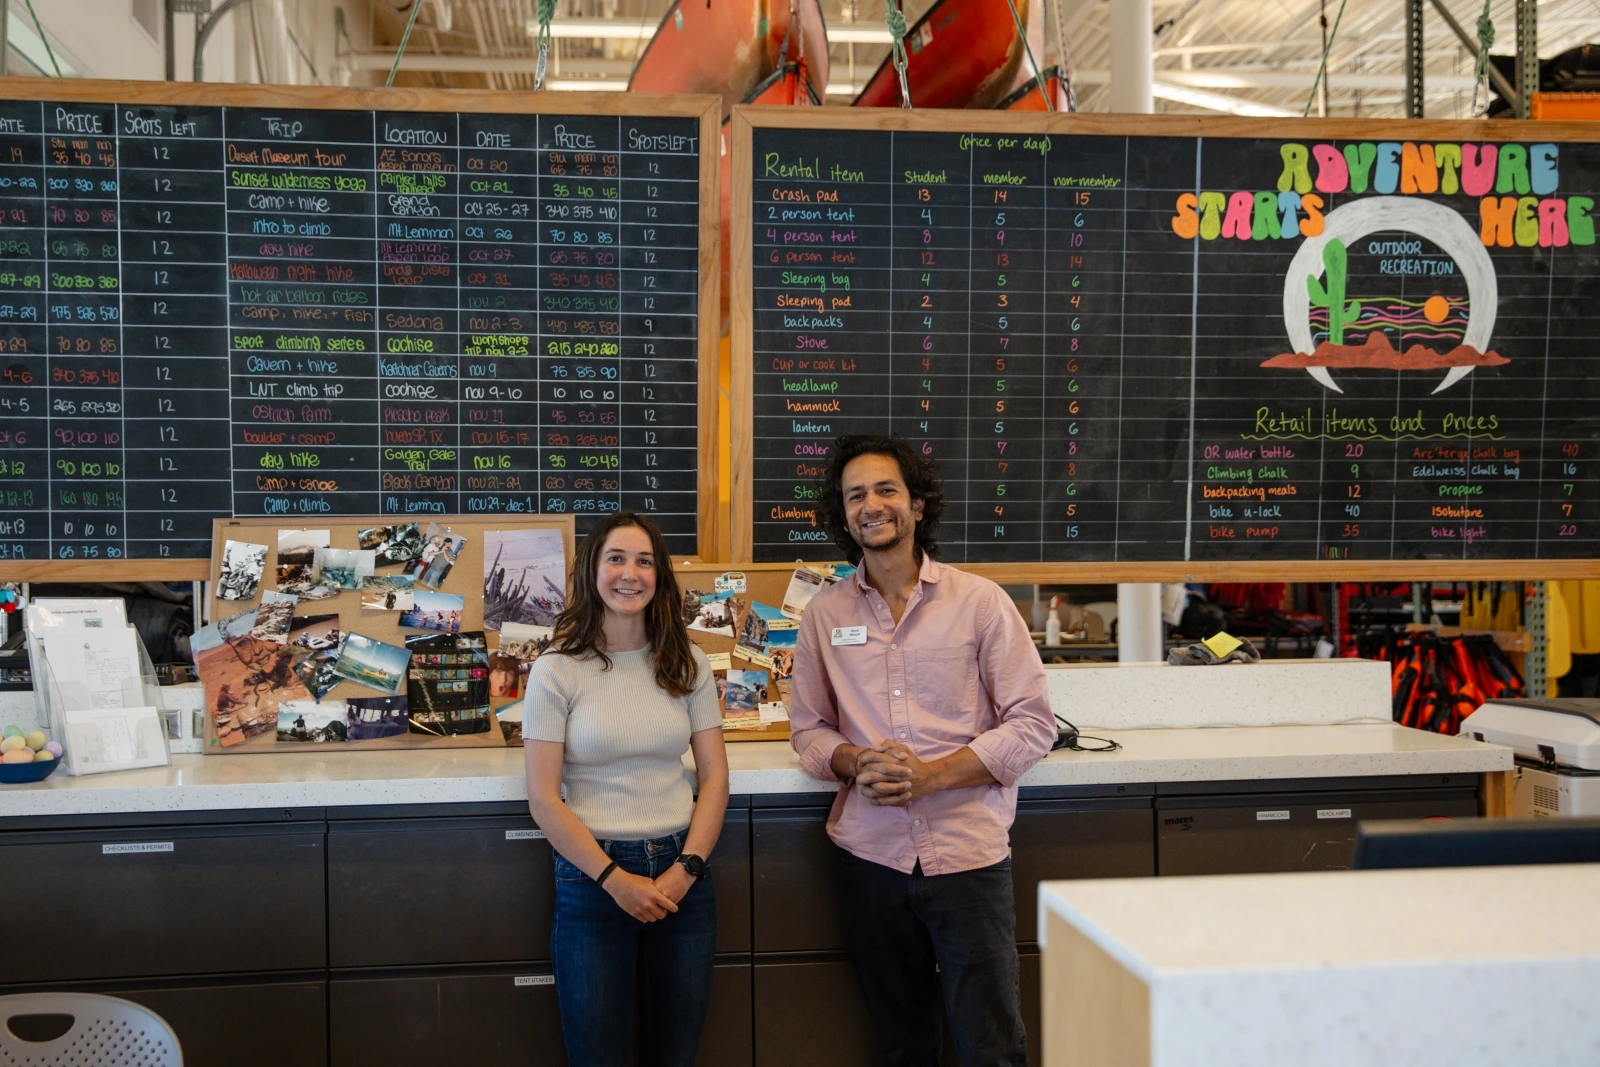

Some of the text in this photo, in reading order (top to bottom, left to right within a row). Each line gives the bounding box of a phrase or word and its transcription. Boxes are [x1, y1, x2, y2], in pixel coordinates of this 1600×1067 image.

[56, 107, 102, 133] PRICE
[125, 111, 196, 137] SPOTS LEFT
[261, 117, 302, 138] TRIP
[385, 123, 447, 146] LOCATION
[476, 131, 511, 147] DATE
[554, 124, 596, 149] PRICE
[997, 138, 1018, 151] per
[261, 147, 309, 166] Museum
[314, 148, 347, 166] tour
[765, 152, 864, 182] Rental item
[1277, 142, 1559, 197] ADVENTURE
[155, 179, 172, 191] 12
[334, 176, 367, 192] yoga
[983, 171, 1026, 185] member
[1054, 174, 1121, 188] non-member
[553, 184, 618, 200] 35 40 45
[918, 189, 931, 201] 13
[994, 190, 1007, 203] 14
[1075, 192, 1091, 205] 15
[298, 195, 331, 213] hike
[768, 207, 855, 222] 2 person tent
[921, 209, 932, 224] 4
[995, 213, 1006, 225] 5
[1074, 213, 1084, 227] 6
[1171, 190, 1326, 241] STARTS
[253, 218, 331, 236] intro to climb
[1479, 197, 1596, 248] HERE
[405, 223, 453, 239] Lemmon
[550, 230, 613, 244] 70 80 85
[643, 230, 656, 242] 12
[767, 229, 857, 244] 4 person tent
[1368, 241, 1422, 257] OUTDOOR
[769, 250, 856, 264] 6 person tent
[1379, 259, 1454, 276] RECREATION
[832, 273, 851, 291] bag
[832, 296, 851, 310] pad
[921, 295, 932, 307] 2
[998, 294, 1008, 307] 3
[1071, 295, 1080, 308] 4
[924, 316, 932, 328] 4
[275, 335, 320, 352] climbing
[327, 336, 365, 351] series
[796, 335, 828, 349] Stove
[923, 335, 932, 350] 6
[307, 358, 338, 373] hike
[799, 361, 809, 369] or
[813, 358, 835, 370] cook
[842, 359, 856, 371] kit
[922, 358, 930, 370] 4
[996, 359, 1005, 371] 5
[1067, 359, 1078, 372] 6
[249, 380, 343, 400] LNT climb trip
[783, 378, 838, 393] headlamp
[923, 380, 931, 392] 4
[787, 399, 841, 412] hammock
[921, 400, 929, 411] 4
[793, 420, 830, 432] lantern
[920, 421, 928, 432] 4
[1255, 406, 1311, 433] Retail
[1326, 408, 1377, 434] items
[1390, 410, 1425, 432] and
[384, 448, 424, 460] Golden
[923, 441, 932, 454] 6
[1204, 445, 1295, 459] OR water bottle
[1345, 443, 1363, 457] 20
[1562, 444, 1579, 456] 40
[260, 452, 320, 470] day hike
[1503, 447, 1520, 464] bag
[56, 460, 120, 477] 90 100 110
[160, 457, 178, 471] 12
[1351, 464, 1359, 478] 9
[1563, 463, 1577, 475] 16
[1412, 465, 1466, 476] Edelweiss
[1504, 465, 1520, 480] bag
[1203, 484, 1297, 501] backpacking meals
[1348, 485, 1361, 498] 12
[1563, 484, 1574, 496] 7
[1209, 505, 1282, 518] bike u-lock
[1345, 505, 1360, 517] 40
[1562, 504, 1572, 517] 7
[1209, 526, 1279, 538] bike pump
[1342, 524, 1360, 537] 35
[1431, 526, 1486, 544] bike light
[1559, 525, 1576, 536] 20
[1164, 815, 1194, 825] mares
